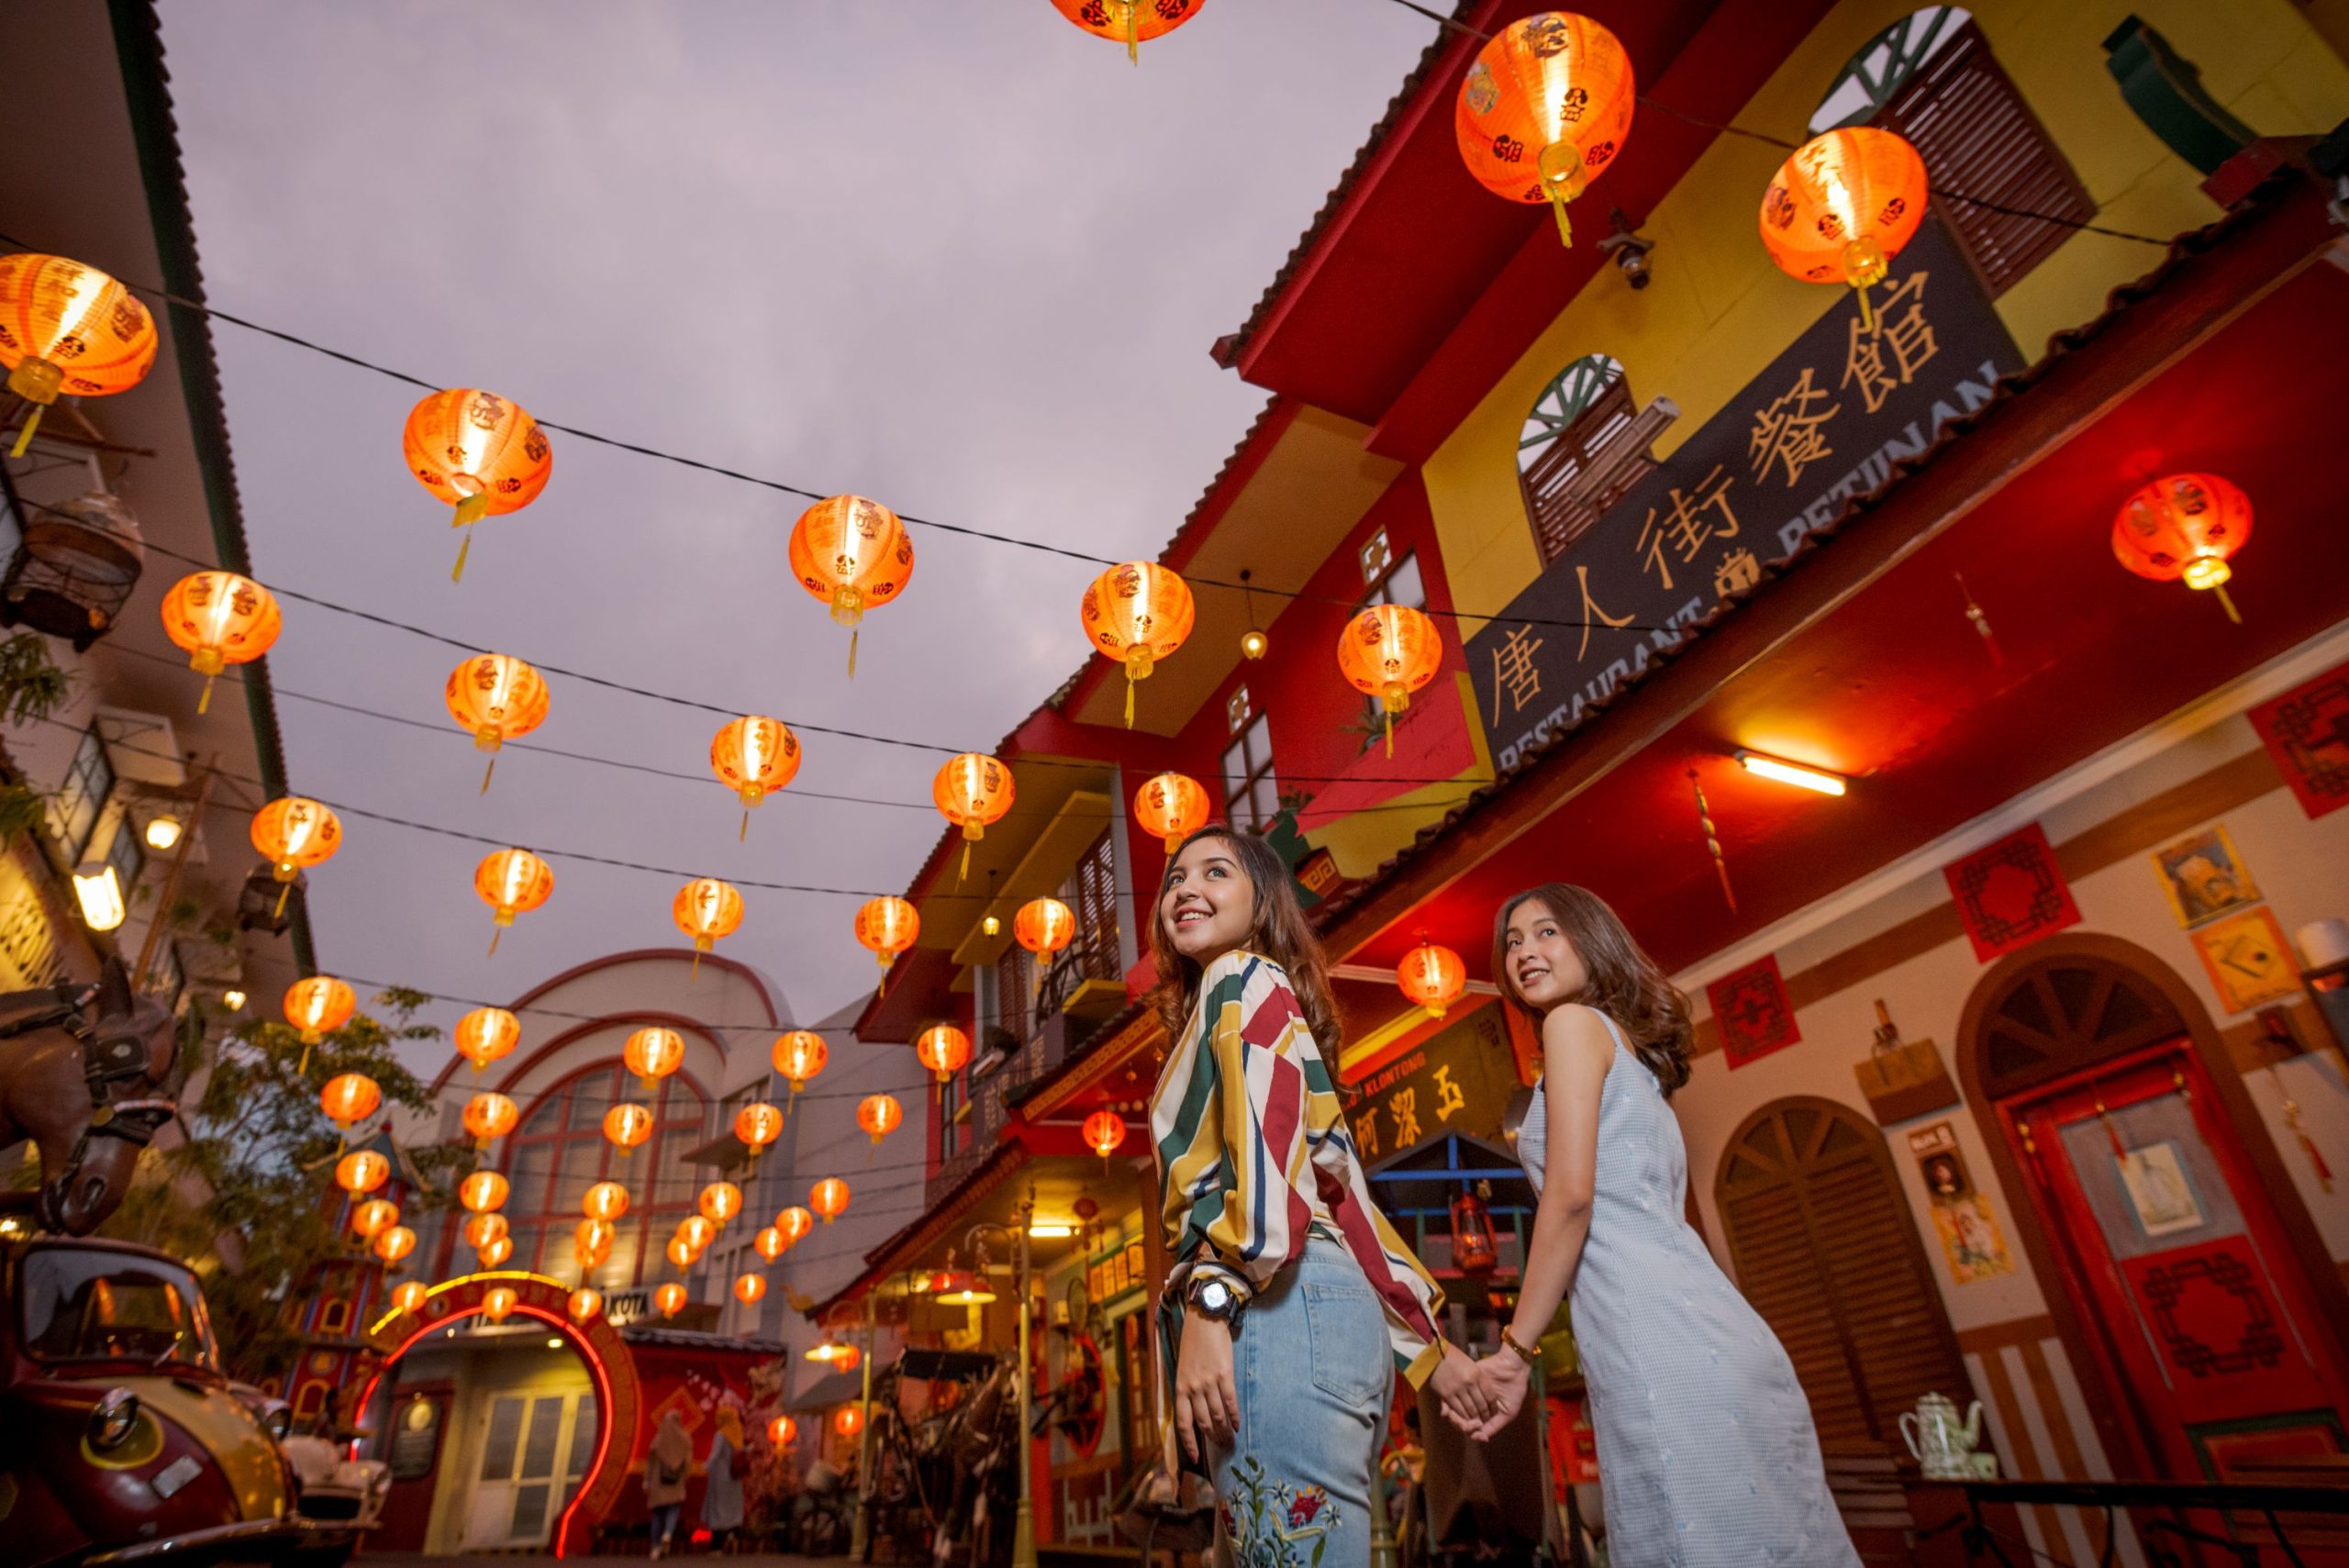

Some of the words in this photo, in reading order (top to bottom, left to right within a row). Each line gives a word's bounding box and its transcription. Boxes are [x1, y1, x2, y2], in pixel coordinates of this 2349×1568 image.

[1493, 272, 1939, 728] 唐人街餐館
